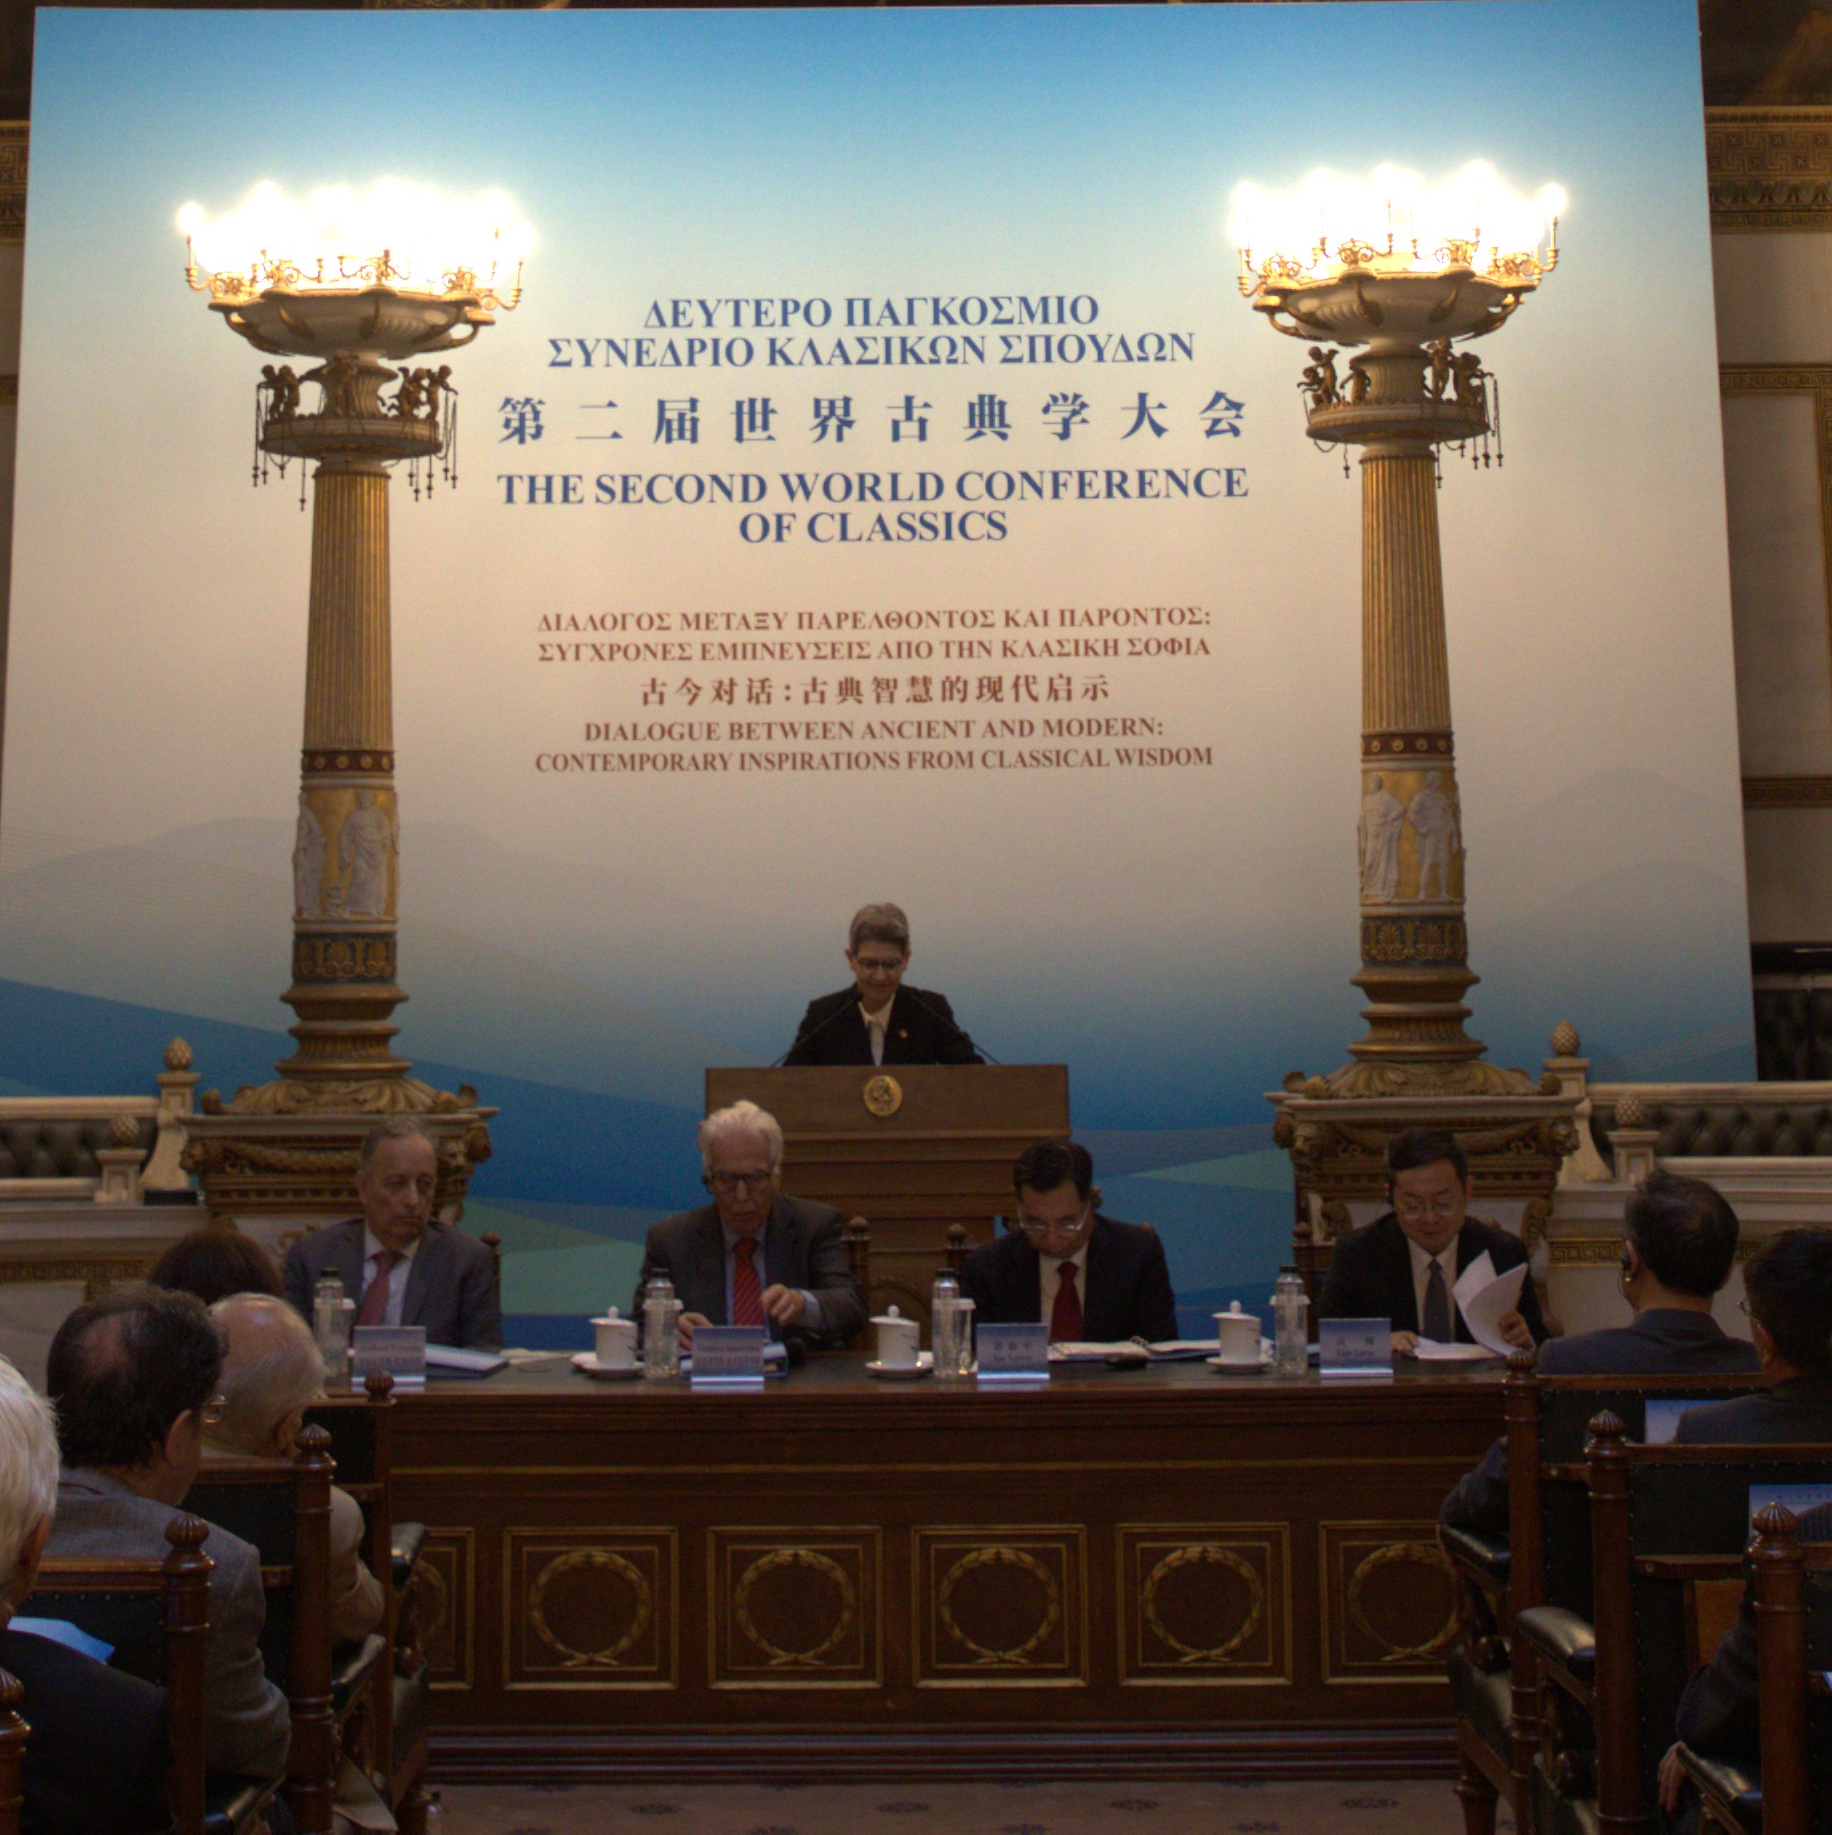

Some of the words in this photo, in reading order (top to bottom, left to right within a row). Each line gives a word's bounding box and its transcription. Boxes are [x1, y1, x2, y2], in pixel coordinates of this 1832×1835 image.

[644, 298, 832, 328] ΔΕΥΤΕΡΟ
[844, 295, 1099, 327] ΠΑΓΚΟΣΜΙΟ
[548, 337, 754, 367] ΣΥΝΕΔΡΙΟ
[766, 335, 986, 366] ΚΛΑΣΙΚΩΝ
[999, 332, 1194, 364] ΣΠΟΥΔΩΝ
[499, 391, 1245, 445] 第二届世界古典学大会
[497, 474, 584, 504] THE
[595, 473, 768, 504] SECOND
[779, 472, 944, 503] WORLD
[955, 468, 1248, 502] CONFERENCE
[739, 513, 796, 543] OF
[807, 510, 1008, 543] CLASSICS
[538, 613, 671, 631] ΔΙΑΛΟΓΟΣ
[680, 612, 788, 631] ΜΕΤΑΞΥ
[797, 610, 995, 630] ΠΑΡΕΛΘΟΝΤΟΣ
[1004, 609, 1049, 628] ΚΑΙ
[1059, 607, 1210, 627] ΠΑΡΟΝΤΟΣ:
[539, 643, 692, 661] ΣΥΓΧΡΟΝΕΣ
[701, 642, 871, 661] ΕΜΠΝΕΥΣΕΙΣ
[877, 641, 933, 659] ΑΠΟ
[940, 640, 992, 659] ΤΗΝ
[1001, 638, 1119, 658] ΚΛΑΣΙΚΗ
[1127, 637, 1211, 656] ΣΟΦΙΑ
[585, 722, 720, 741] DIALOGUE
[729, 721, 853, 741] BETWEEN
[861, 720, 976, 739] ANCIENT
[982, 719, 1035, 738] AND
[1043, 718, 1163, 737] MODERN:
[535, 753, 732, 772] CONTEMPORARY
[740, 751, 900, 771] INSPIRATIONS
[907, 750, 974, 769] FROM
[981, 748, 1110, 769] CLASSICAL
[1115, 747, 1212, 767] WISDOM
